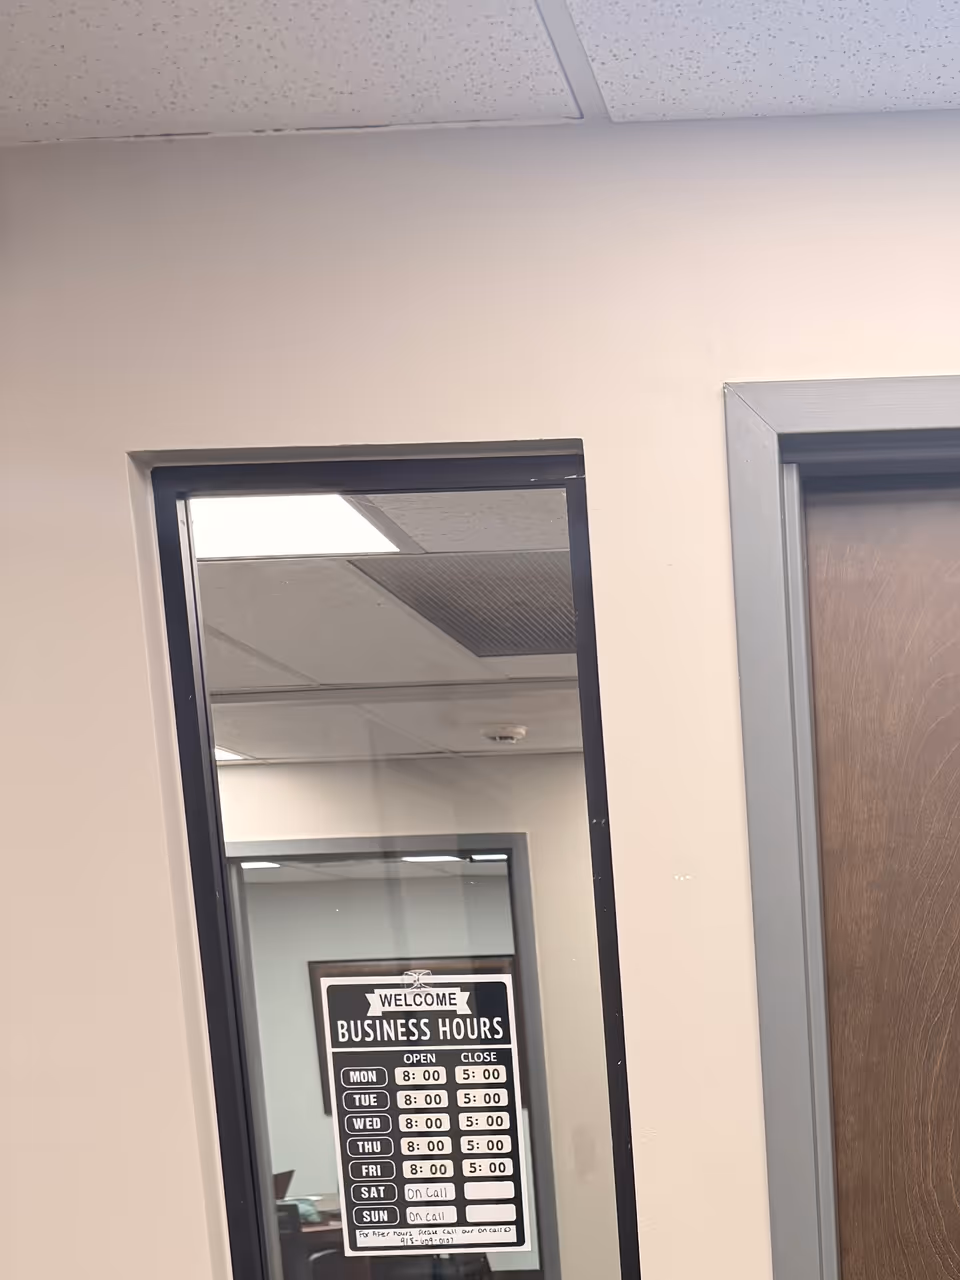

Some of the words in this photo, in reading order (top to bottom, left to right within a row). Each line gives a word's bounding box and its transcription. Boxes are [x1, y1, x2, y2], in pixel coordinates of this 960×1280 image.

[379, 992, 458, 1008] WELCOME
[337, 1018, 431, 1042] BUSINESS
[438, 1016, 504, 1040] HOURS
[403, 1053, 436, 1064] OPEN
[460, 1051, 498, 1063] CLOSE
[349, 1071, 377, 1083] MON
[353, 1094, 378, 1106] TUE
[352, 1118, 381, 1130] WED
[356, 1141, 381, 1153] THU
[361, 1165, 382, 1177] FRI
[360, 1187, 385, 1199] SAT
[362, 1210, 388, 1222] SUN
